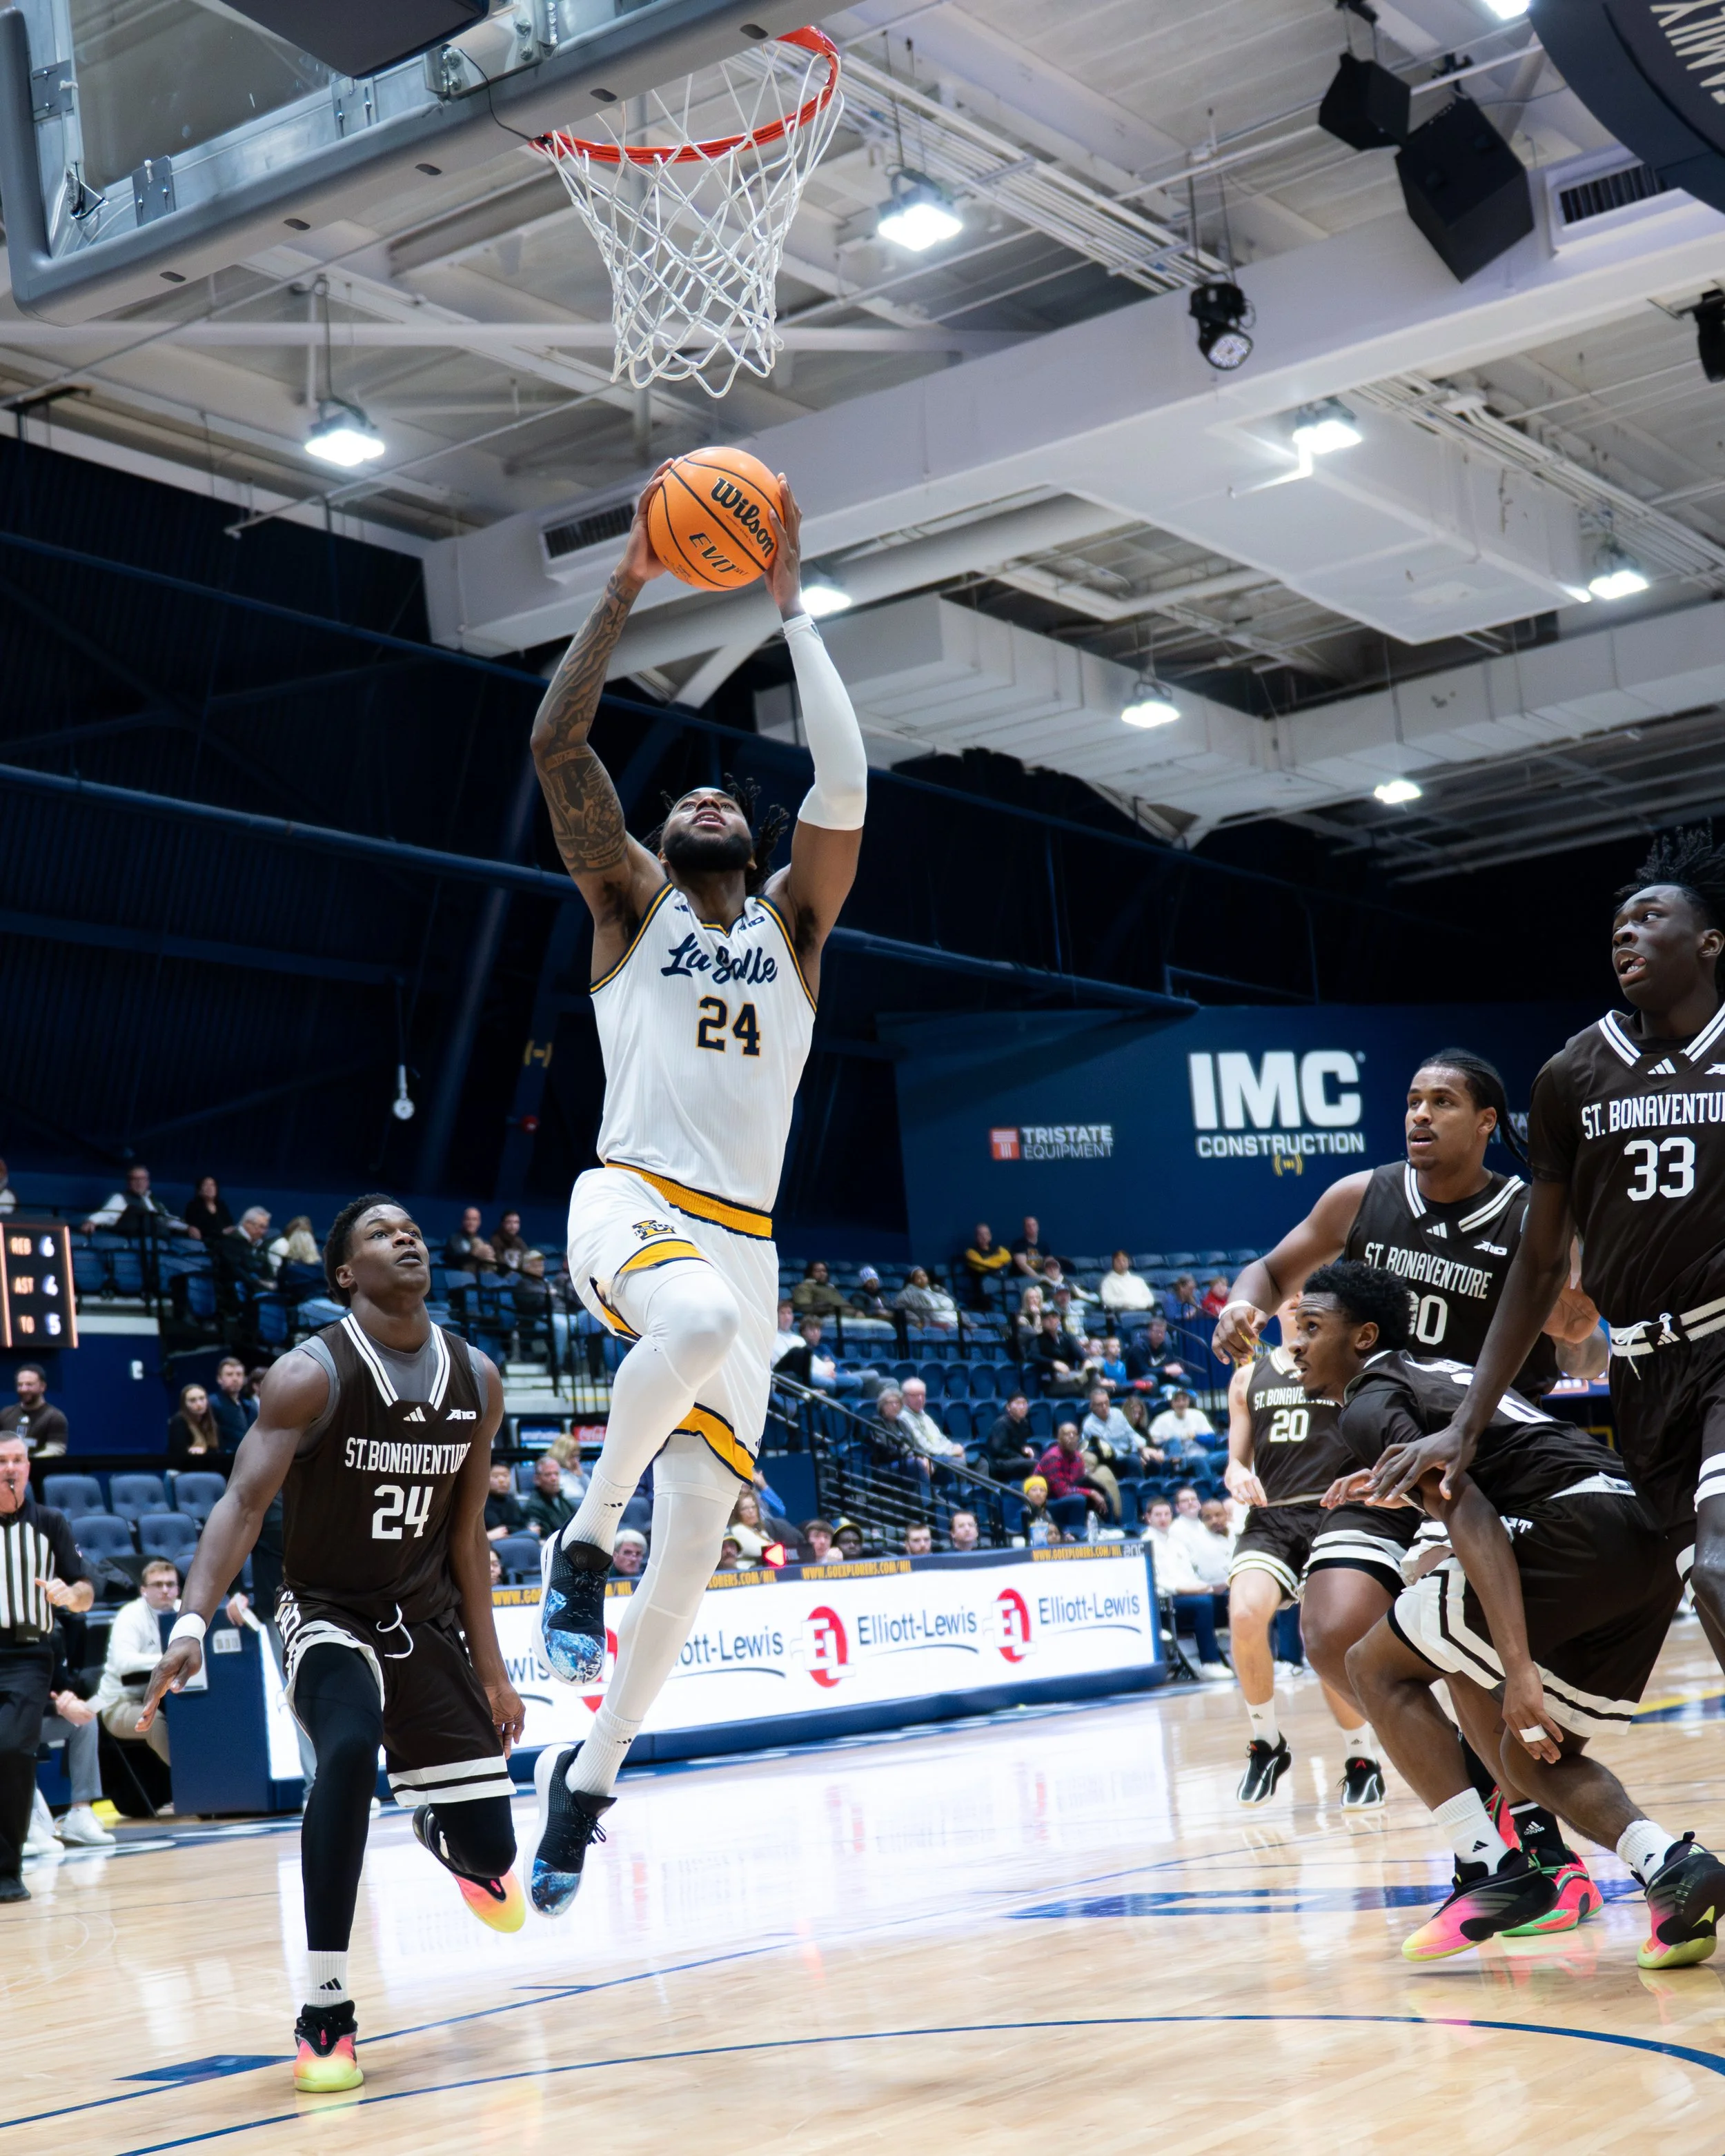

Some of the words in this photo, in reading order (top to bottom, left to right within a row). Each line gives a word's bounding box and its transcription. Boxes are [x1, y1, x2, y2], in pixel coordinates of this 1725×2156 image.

[711, 476, 774, 559] Wilson
[689, 532, 736, 573] EVO
[660, 932, 712, 978] La
[711, 945, 778, 985] Salle
[696, 994, 762, 1058] 24
[1189, 1050, 1361, 1130] IMC
[1021, 1125, 1113, 1144] TRISTATE
[1581, 1103, 1606, 1140] ST.
[1023, 1142, 1113, 1160] EQUIPMENT
[1196, 1131, 1366, 1158] CONSTRUCTION
[1624, 1137, 1695, 1201] 33
[41, 1235, 55, 1257] 6
[14, 1276, 34, 1295] AST
[44, 1274, 59, 1296] 6
[1386, 1247, 1493, 1300] BONAVENTURE
[47, 1313, 61, 1336] 5
[446, 1409, 477, 1421] A10
[1254, 1391, 1265, 1412] ST.
[1269, 1408, 1310, 1443] 20
[345, 1437, 366, 1470] ST.
[372, 1485, 434, 1540] 24
[858, 1605, 978, 1645] Elliott-Lewis
[1038, 1590, 1141, 1625] Elliott-Lewis
[676, 1625, 785, 1666] ott-Lewis
